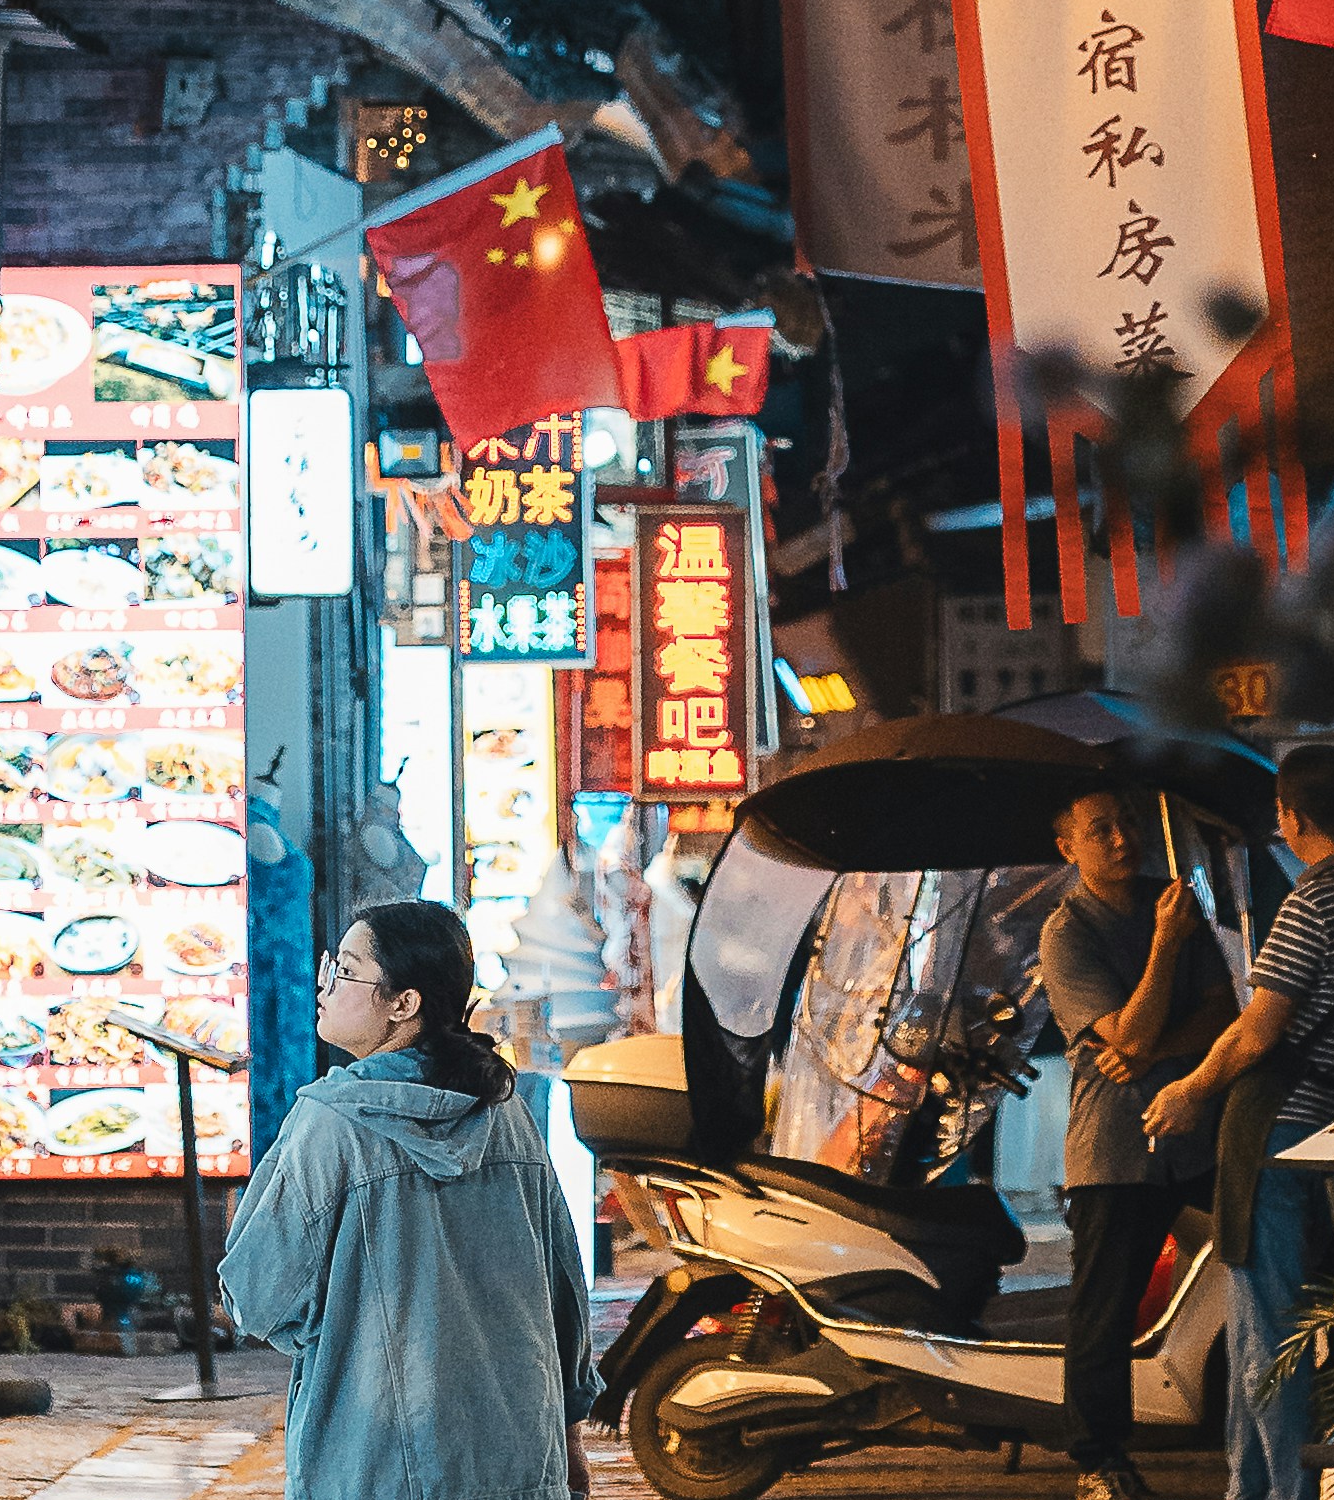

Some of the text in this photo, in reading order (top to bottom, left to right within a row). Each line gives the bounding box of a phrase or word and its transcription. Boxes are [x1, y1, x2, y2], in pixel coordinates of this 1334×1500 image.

[464, 465, 575, 525] 奶茶
[469, 528, 578, 589] 冰沙
[469, 591, 577, 653] 水果茶
